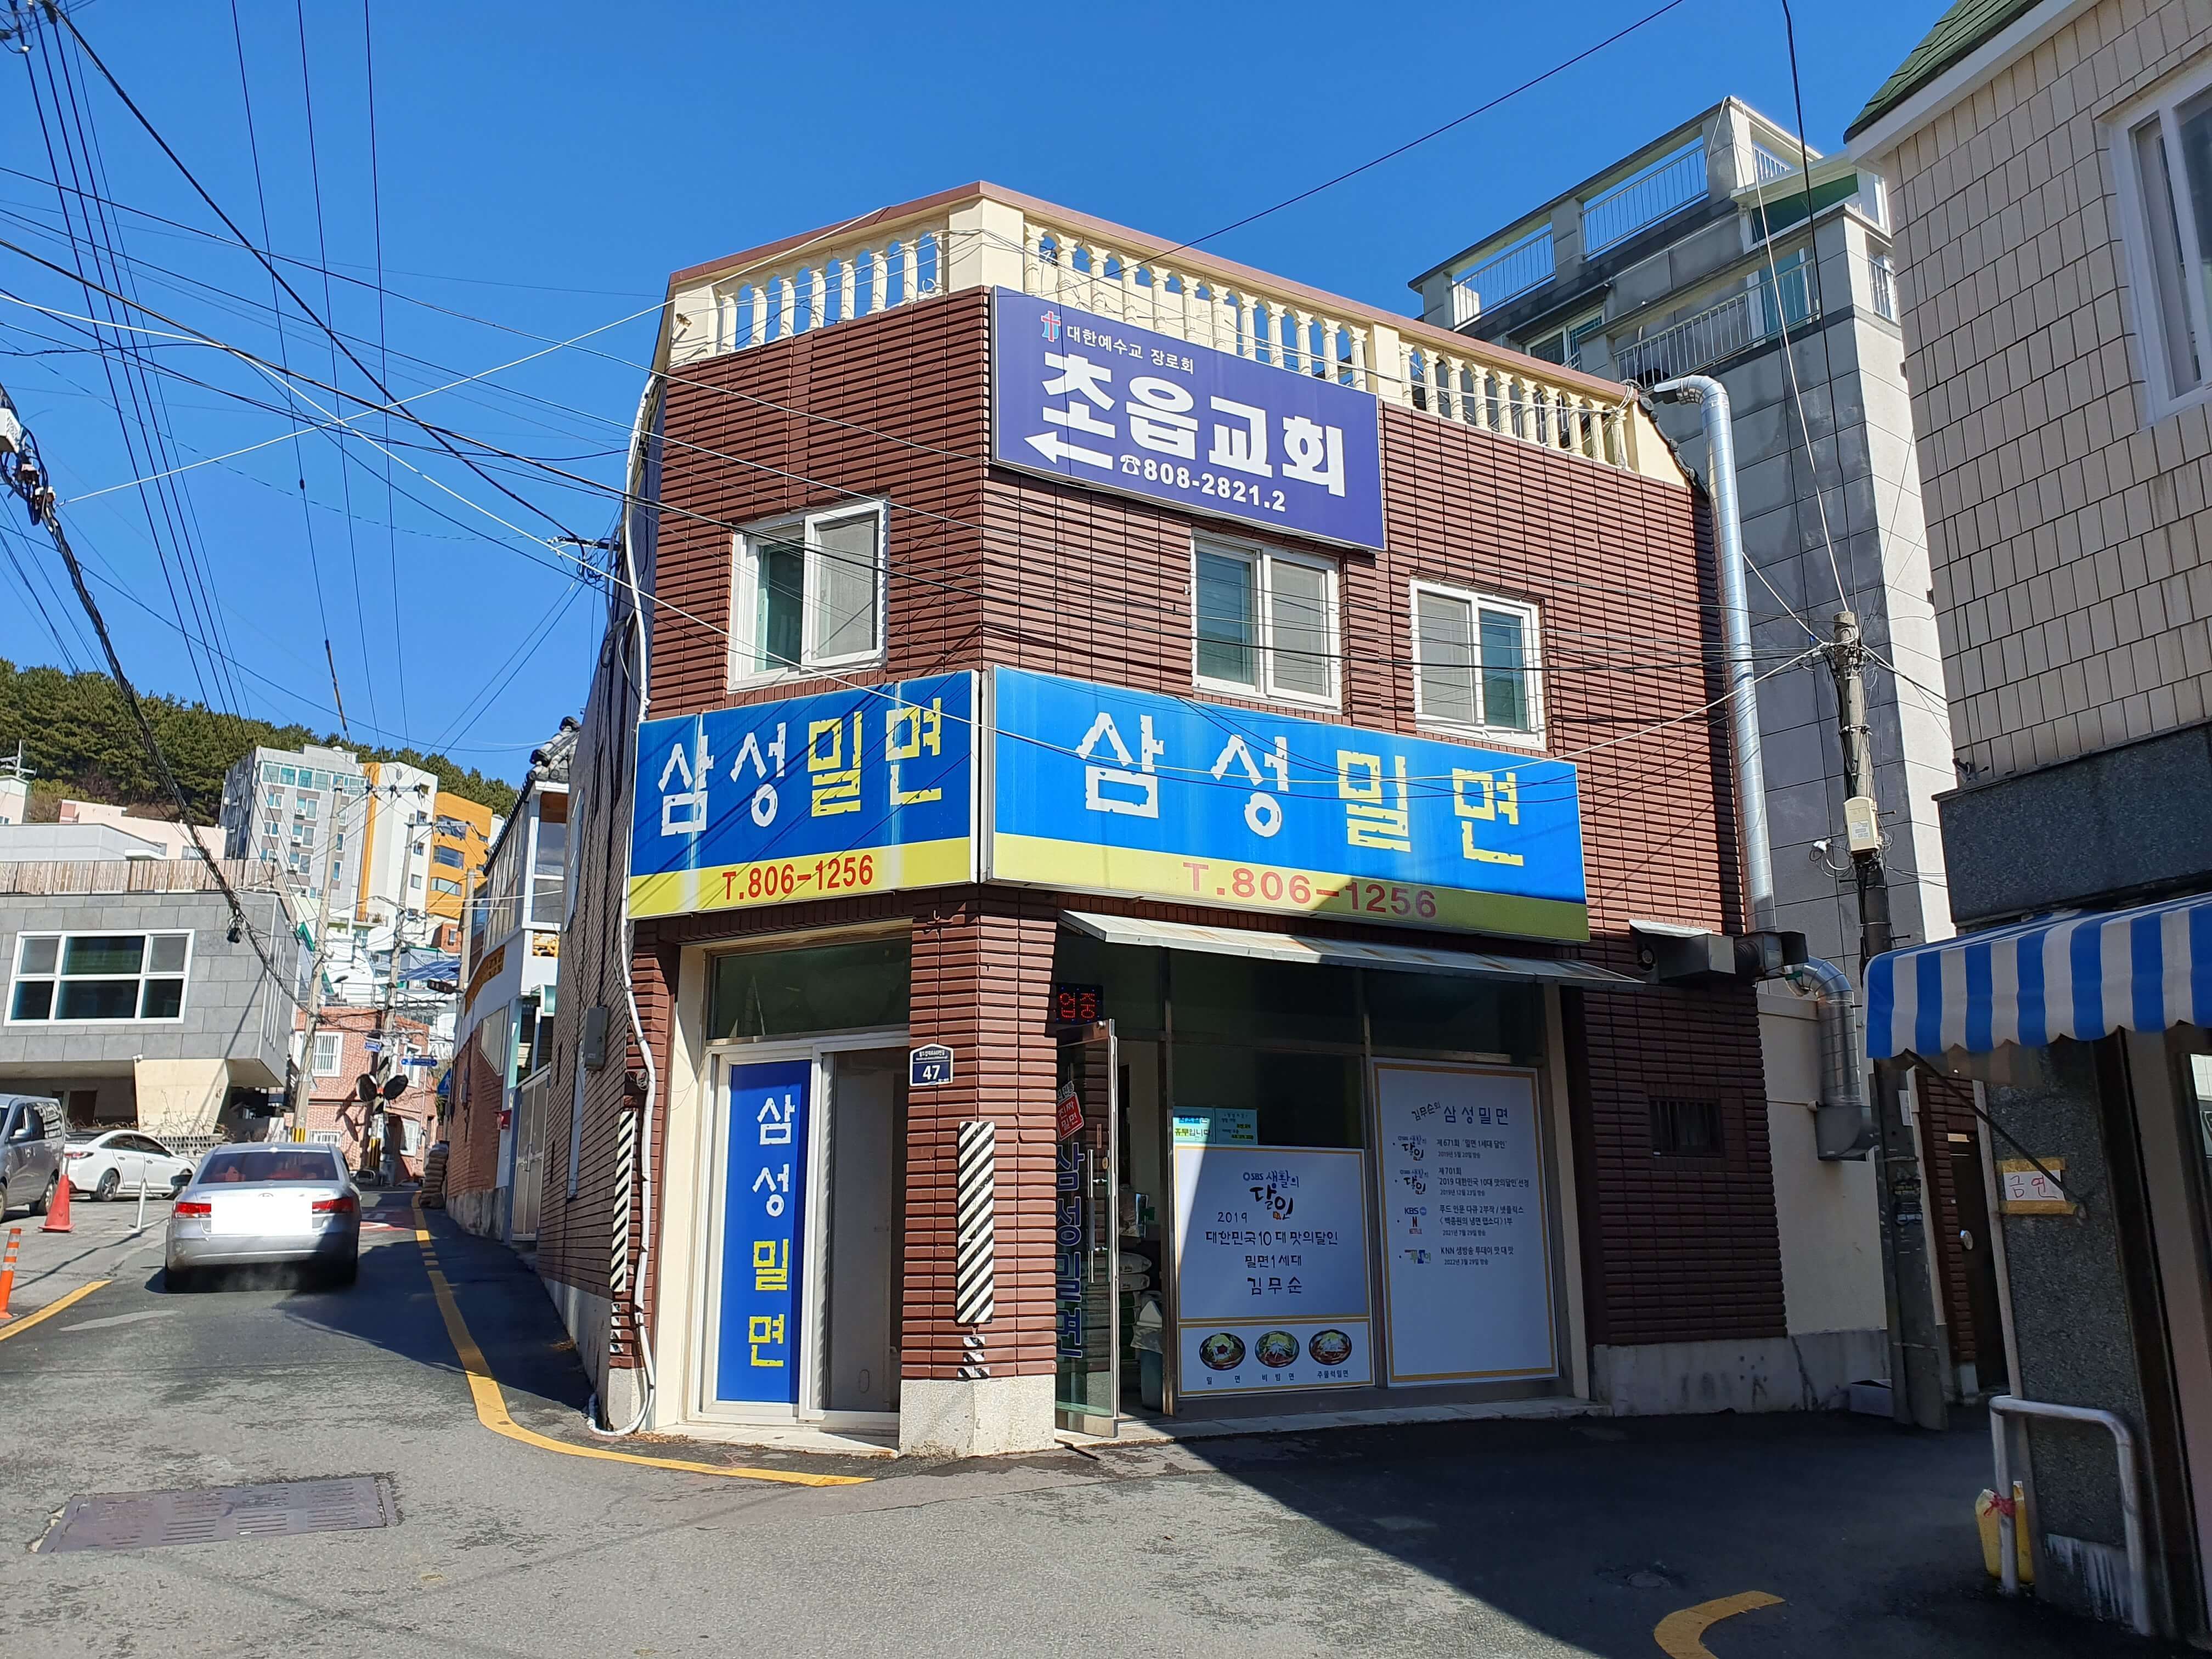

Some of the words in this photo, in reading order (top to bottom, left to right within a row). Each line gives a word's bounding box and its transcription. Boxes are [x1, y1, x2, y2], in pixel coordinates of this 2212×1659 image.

[1066, 324, 1143, 360] 대한예수교
[1150, 347, 1194, 375] 장로회
[1041, 351, 1346, 498] 초읍교회
[1144, 460, 1286, 512] 808-2821.2
[658, 697, 942, 837] 삼성밀면
[1075, 711, 1524, 867] 삼성밀면
[722, 855, 874, 901] T.806-1256
[1182, 861, 1437, 918] T.806-1256
[922, 1064, 940, 1080] 47
[1412, 1101, 1441, 1121] 김무순의
[1444, 1105, 1509, 1125] 삼성밀면
[1266, 1170, 1299, 1188] 생활의
[1438, 1166, 1462, 1175] 제701회
[1455, 1178, 1479, 1186] 대한민국
[1250, 1184, 1294, 1220] 달인
[2010, 1175, 2058, 1200] 금연
[1217, 1211, 1248, 1223] 2019
[1404, 1206, 1419, 1215] KBS
[749, 1094, 795, 1367] 삼성밀면
[1441, 1246, 1455, 1255] KNN
